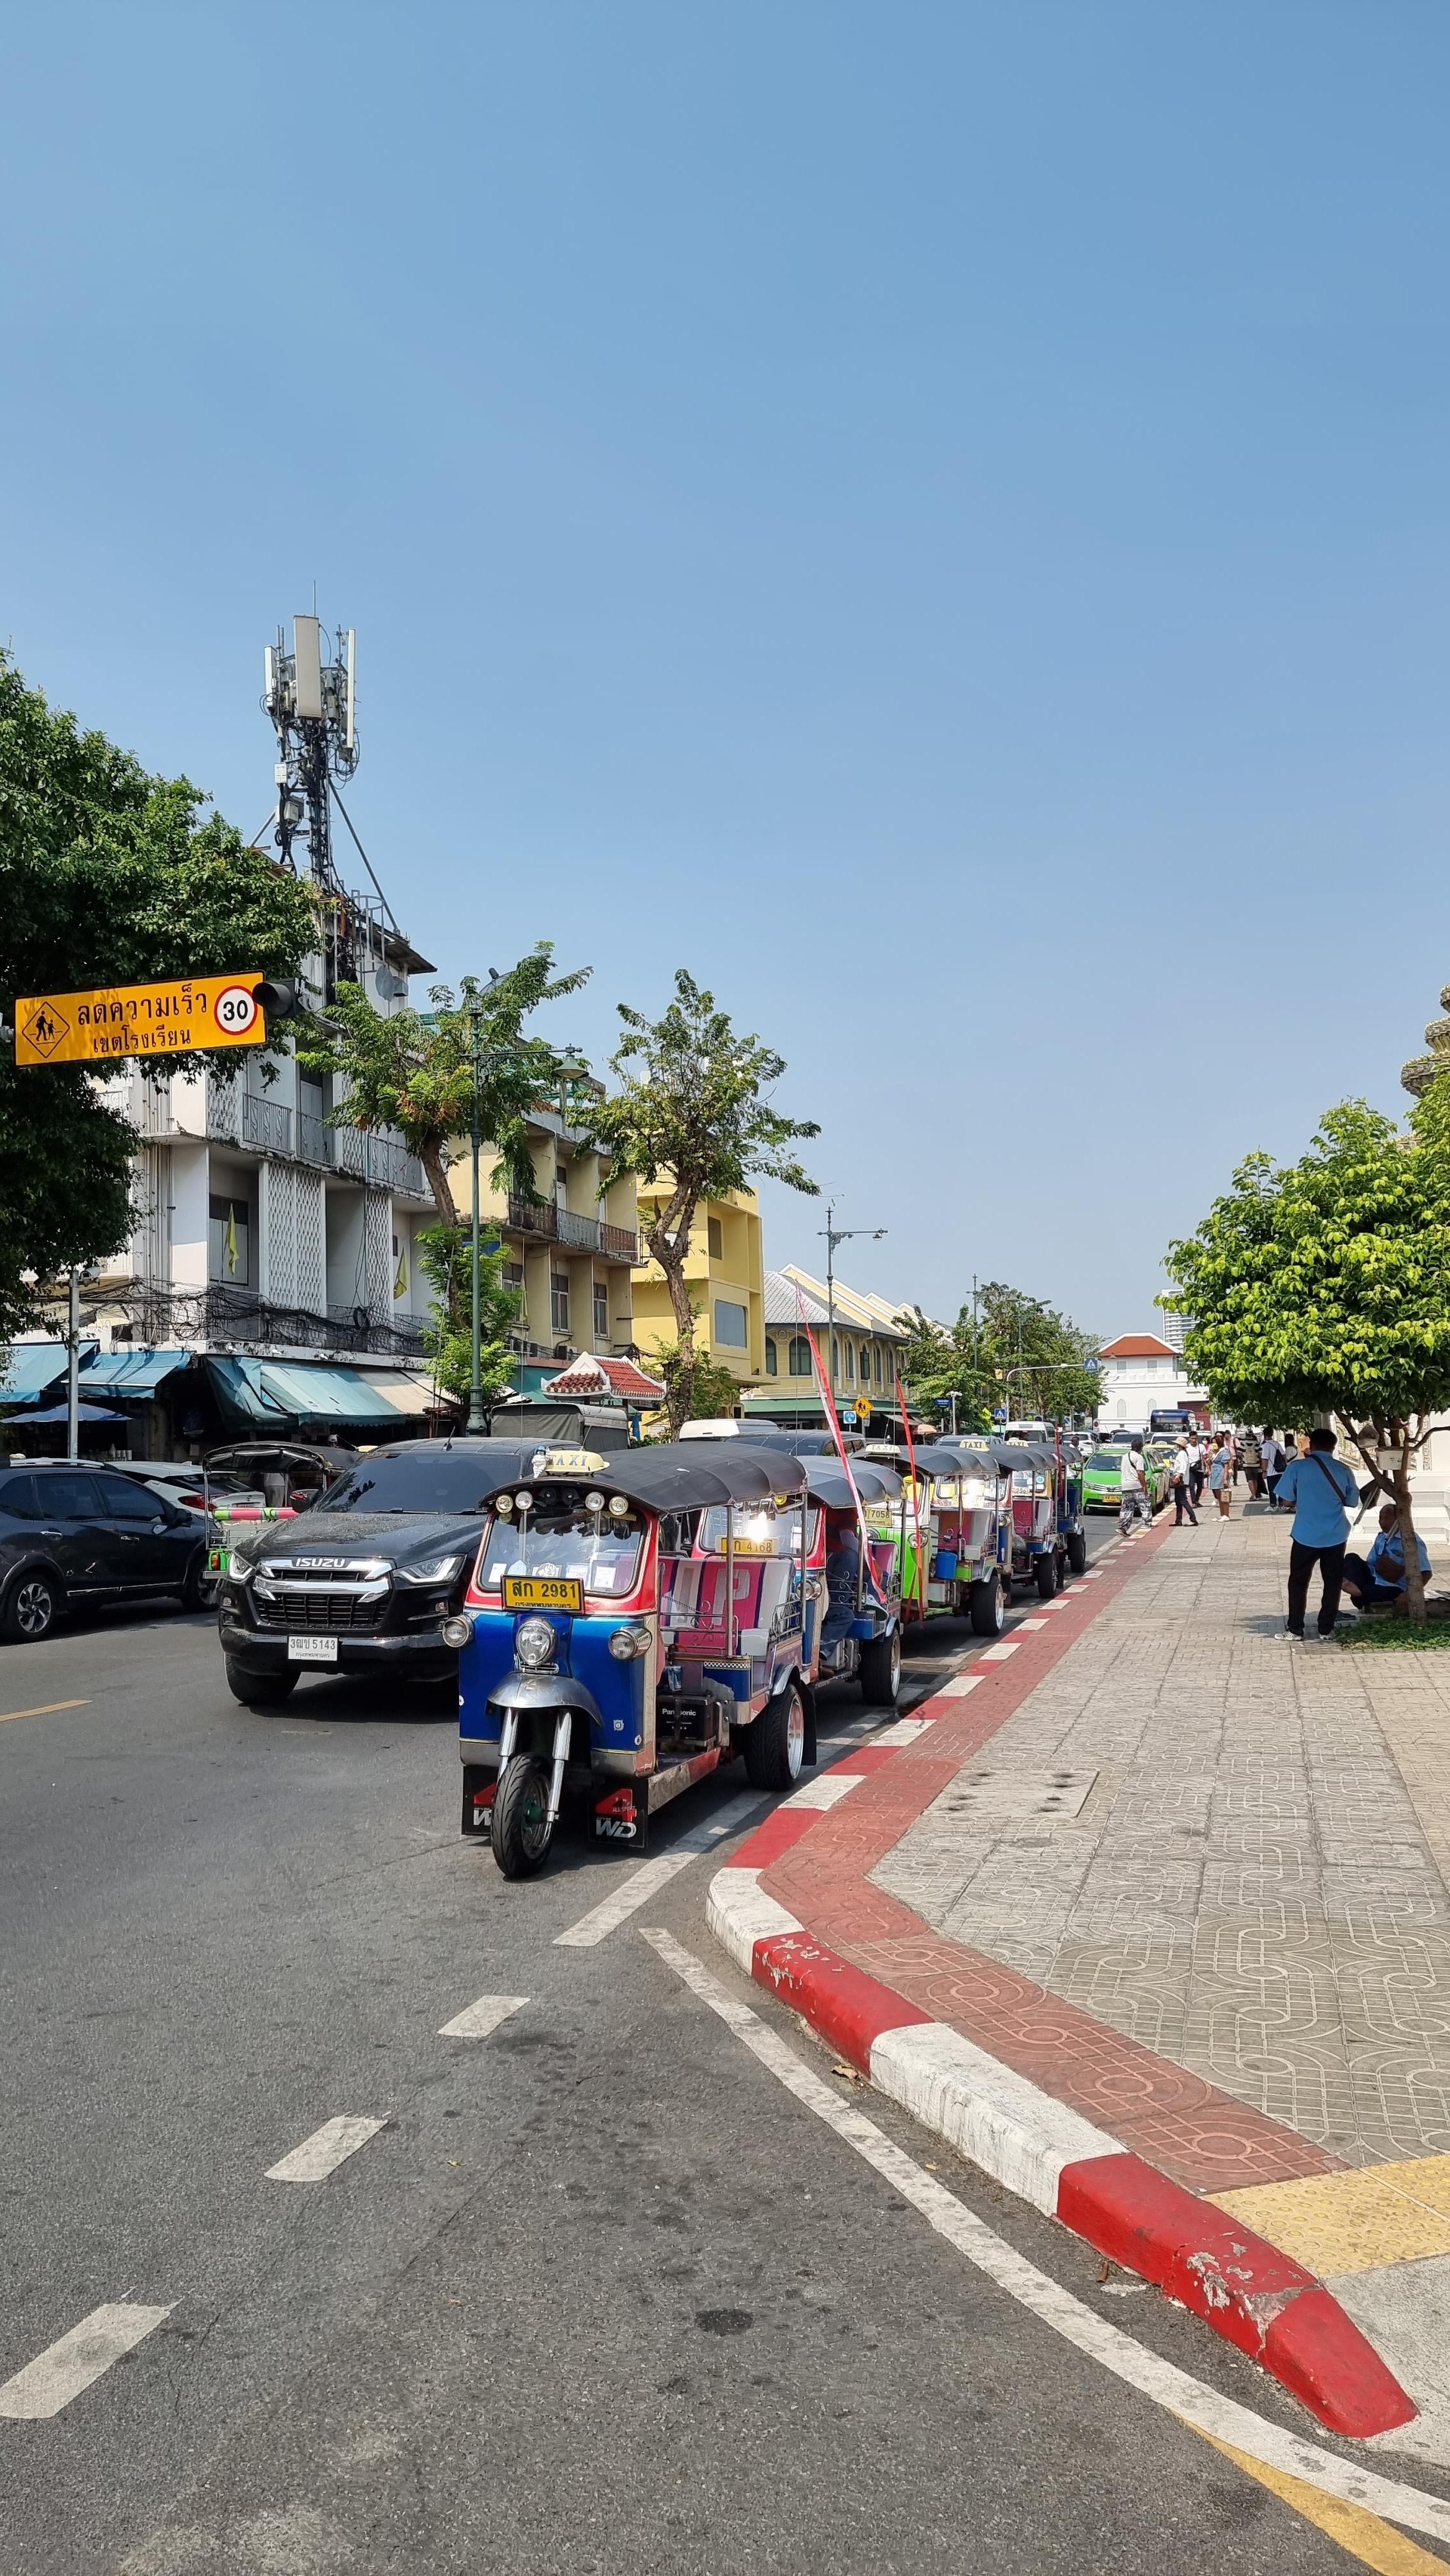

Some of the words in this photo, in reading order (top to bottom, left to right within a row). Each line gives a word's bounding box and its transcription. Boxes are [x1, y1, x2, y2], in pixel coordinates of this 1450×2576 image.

[77, 983, 208, 1026] ลดความเร็ว
[224, 999, 248, 1021] 30
[93, 1024, 191, 1054] เขตโรงเรียน
[547, 1454, 588, 1466] TAXI
[871, 1509, 890, 1519] 7058
[746, 1541, 772, 1552] 4168
[295, 1558, 345, 1568] ISUZU
[512, 1581, 533, 1597] สก
[541, 1583, 576, 1598] 2981
[312, 1639, 335, 1650] 5143
[662, 1708, 696, 1716] Pansonic
[596, 1818, 637, 1839] WD
